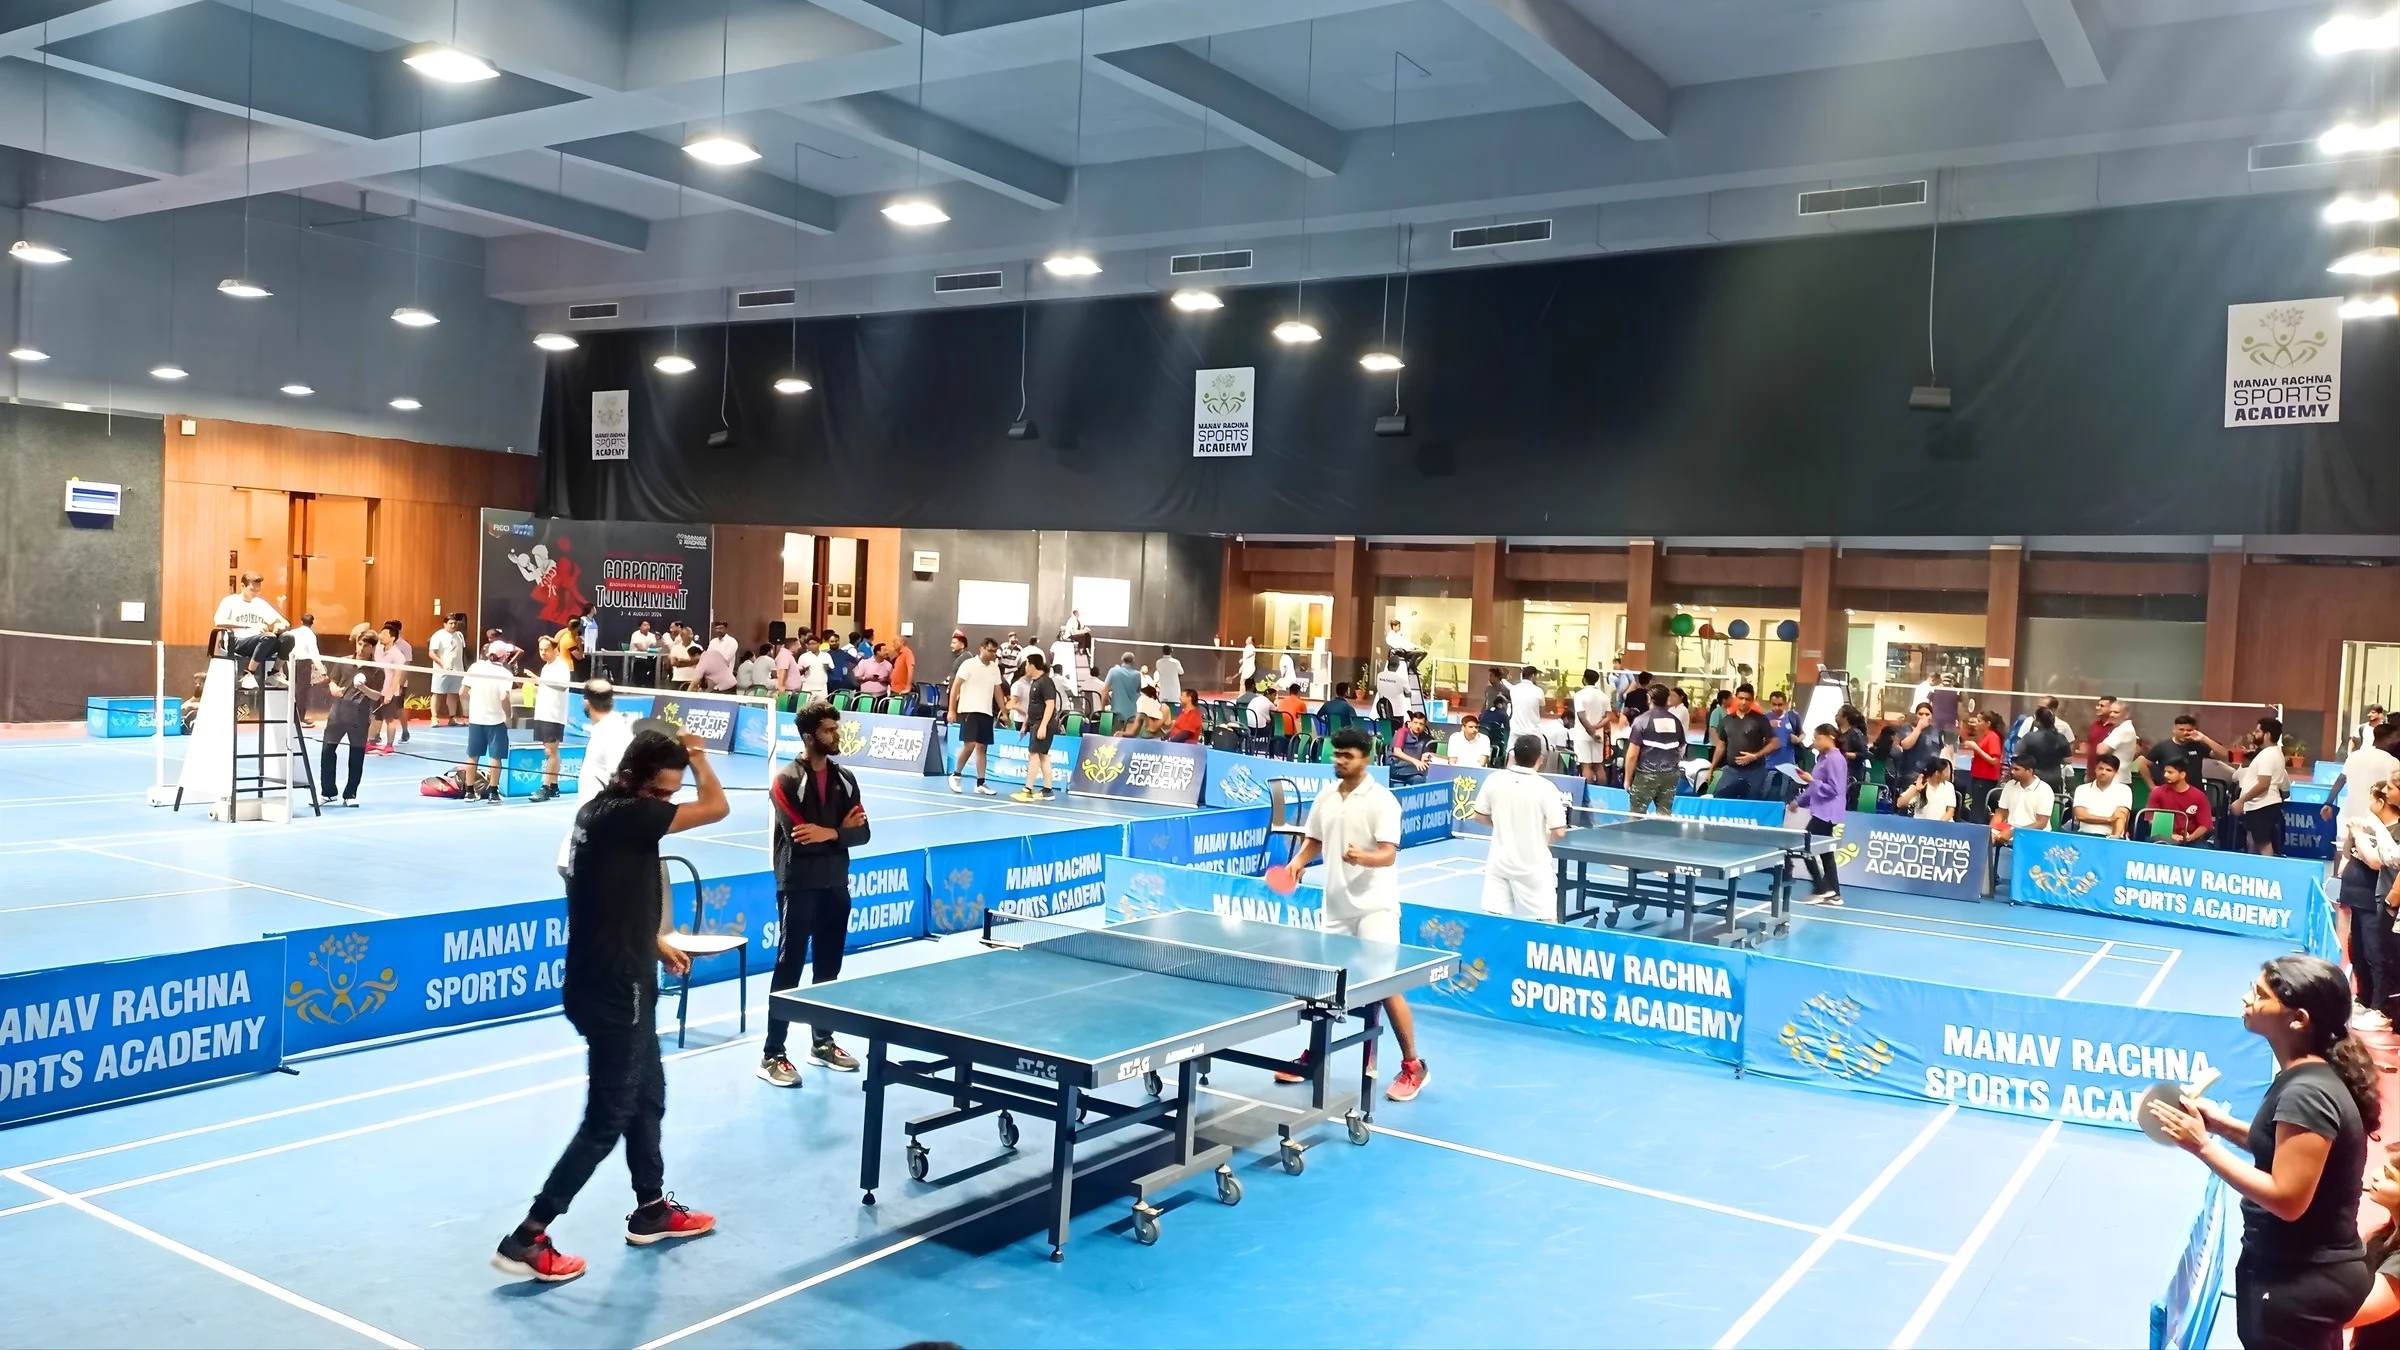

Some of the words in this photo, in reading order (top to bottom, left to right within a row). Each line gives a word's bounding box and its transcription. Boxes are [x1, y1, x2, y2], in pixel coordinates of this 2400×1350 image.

[2233, 377, 2277, 388] MANAV
[2281, 374, 2333, 386] RACHNA
[2233, 384, 2332, 406] SPORTS
[1223, 421, 1250, 429] RACHNA
[2234, 404, 2330, 422] ACADEMY
[1198, 428, 1249, 442] SPORTS
[1198, 442, 1248, 453] ACADEMY
[604, 559, 684, 585] CORPORATE
[596, 585, 688, 610] TOURNAMENT
[686, 714, 730, 730] SPORTS
[1125, 773, 1191, 791] ACADEMY
[1128, 759, 1194, 780] SPORTS
[2284, 812, 2315, 829] HNA
[1193, 832, 1230, 855] MANAV
[1869, 830, 1916, 844] MANAV
[1918, 835, 1971, 851] RACHNA
[1867, 840, 1970, 869] SPORTS
[1005, 862, 1054, 891] MANAV
[1054, 851, 1103, 884] RACHNA
[1864, 858, 1968, 884] ACADEMY
[2126, 860, 2196, 888] MANAV
[2201, 869, 2283, 901] RACHNA
[1052, 880, 1106, 915] ACADEMY
[1213, 893, 1282, 926] MANAV
[2113, 885, 2188, 914] SPORTS
[2192, 896, 2292, 929] ACADEMY
[847, 900, 915, 934] CADEMY
[443, 919, 538, 964] MANAV
[1526, 940, 1617, 981] MANAV
[1623, 954, 1733, 999] RACHNA
[425, 964, 528, 1012] SPORTS
[0, 993, 101, 1047] ANAV
[112, 969, 251, 1027] RACHNA
[1510, 977, 1607, 1020] SPORTS
[1613, 994, 1744, 1043] ACADEMY
[0, 1049, 84, 1102] ORTS
[93, 1015, 267, 1083] ACADEMY
[1943, 1023, 2062, 1069] MANAV
[2071, 1037, 2212, 1084] RACHNA
[1015, 1057, 1058, 1081] STAG
[1117, 1055, 1151, 1081] STAG
[1924, 1064, 2051, 1114] SPORTS
